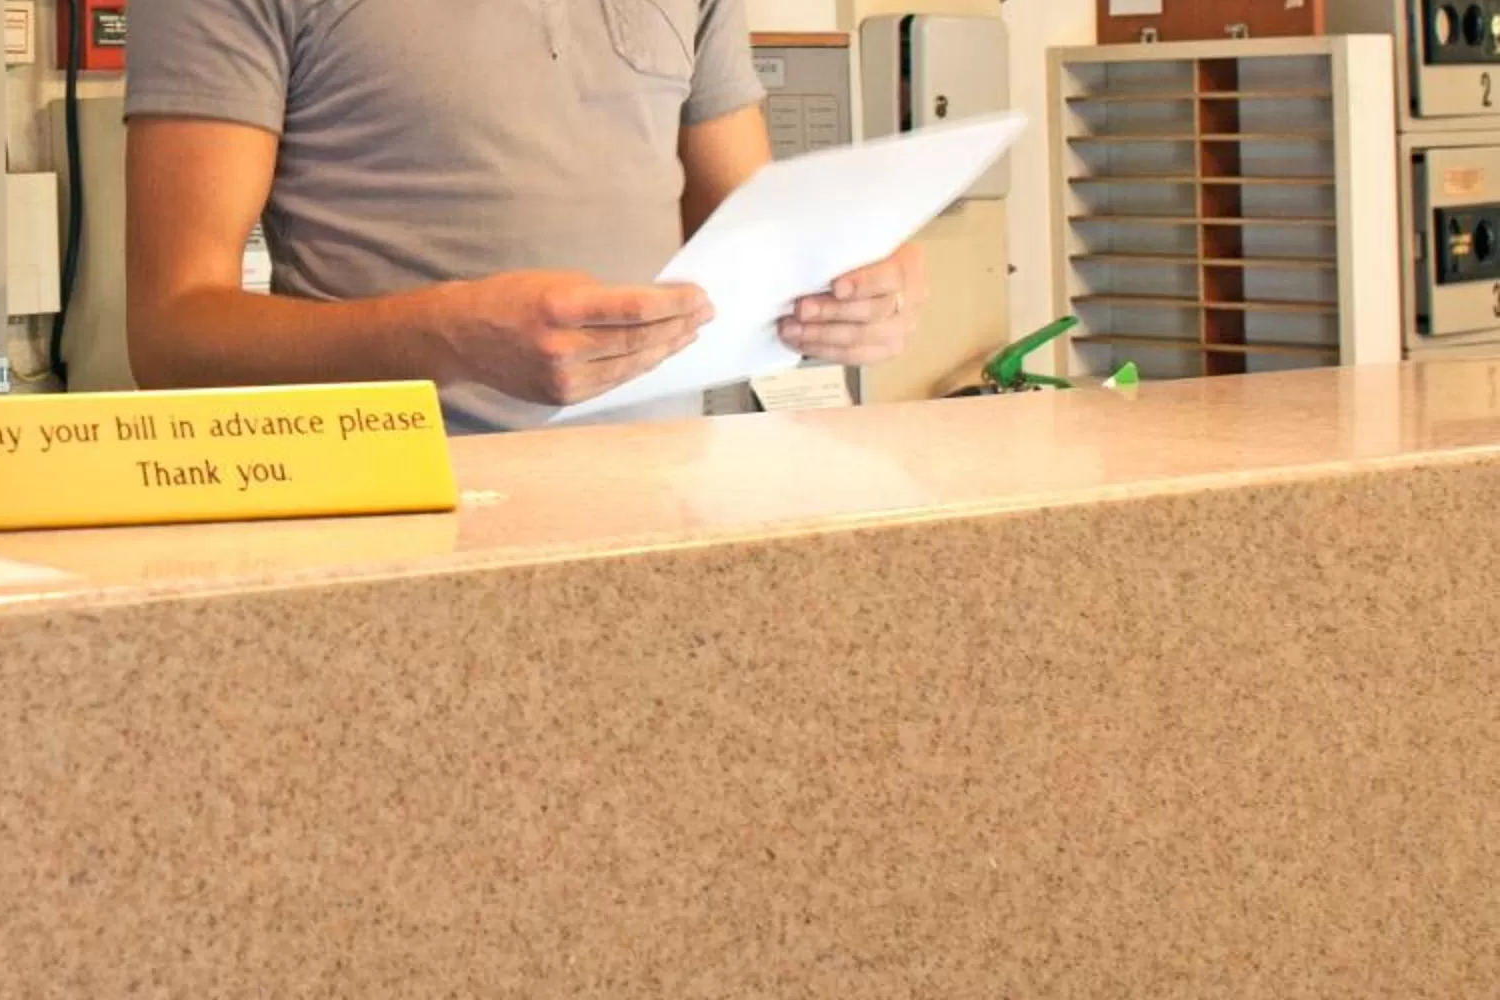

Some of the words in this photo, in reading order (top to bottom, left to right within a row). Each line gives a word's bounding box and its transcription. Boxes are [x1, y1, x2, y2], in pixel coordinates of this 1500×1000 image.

[1480, 72, 1492, 108] 2
[39, 421, 101, 452] your
[115, 414, 157, 442] bill
[171, 415, 195, 440] in
[209, 410, 325, 437] advance
[137, 459, 221, 488] Thank
[237, 464, 293, 492] you.
